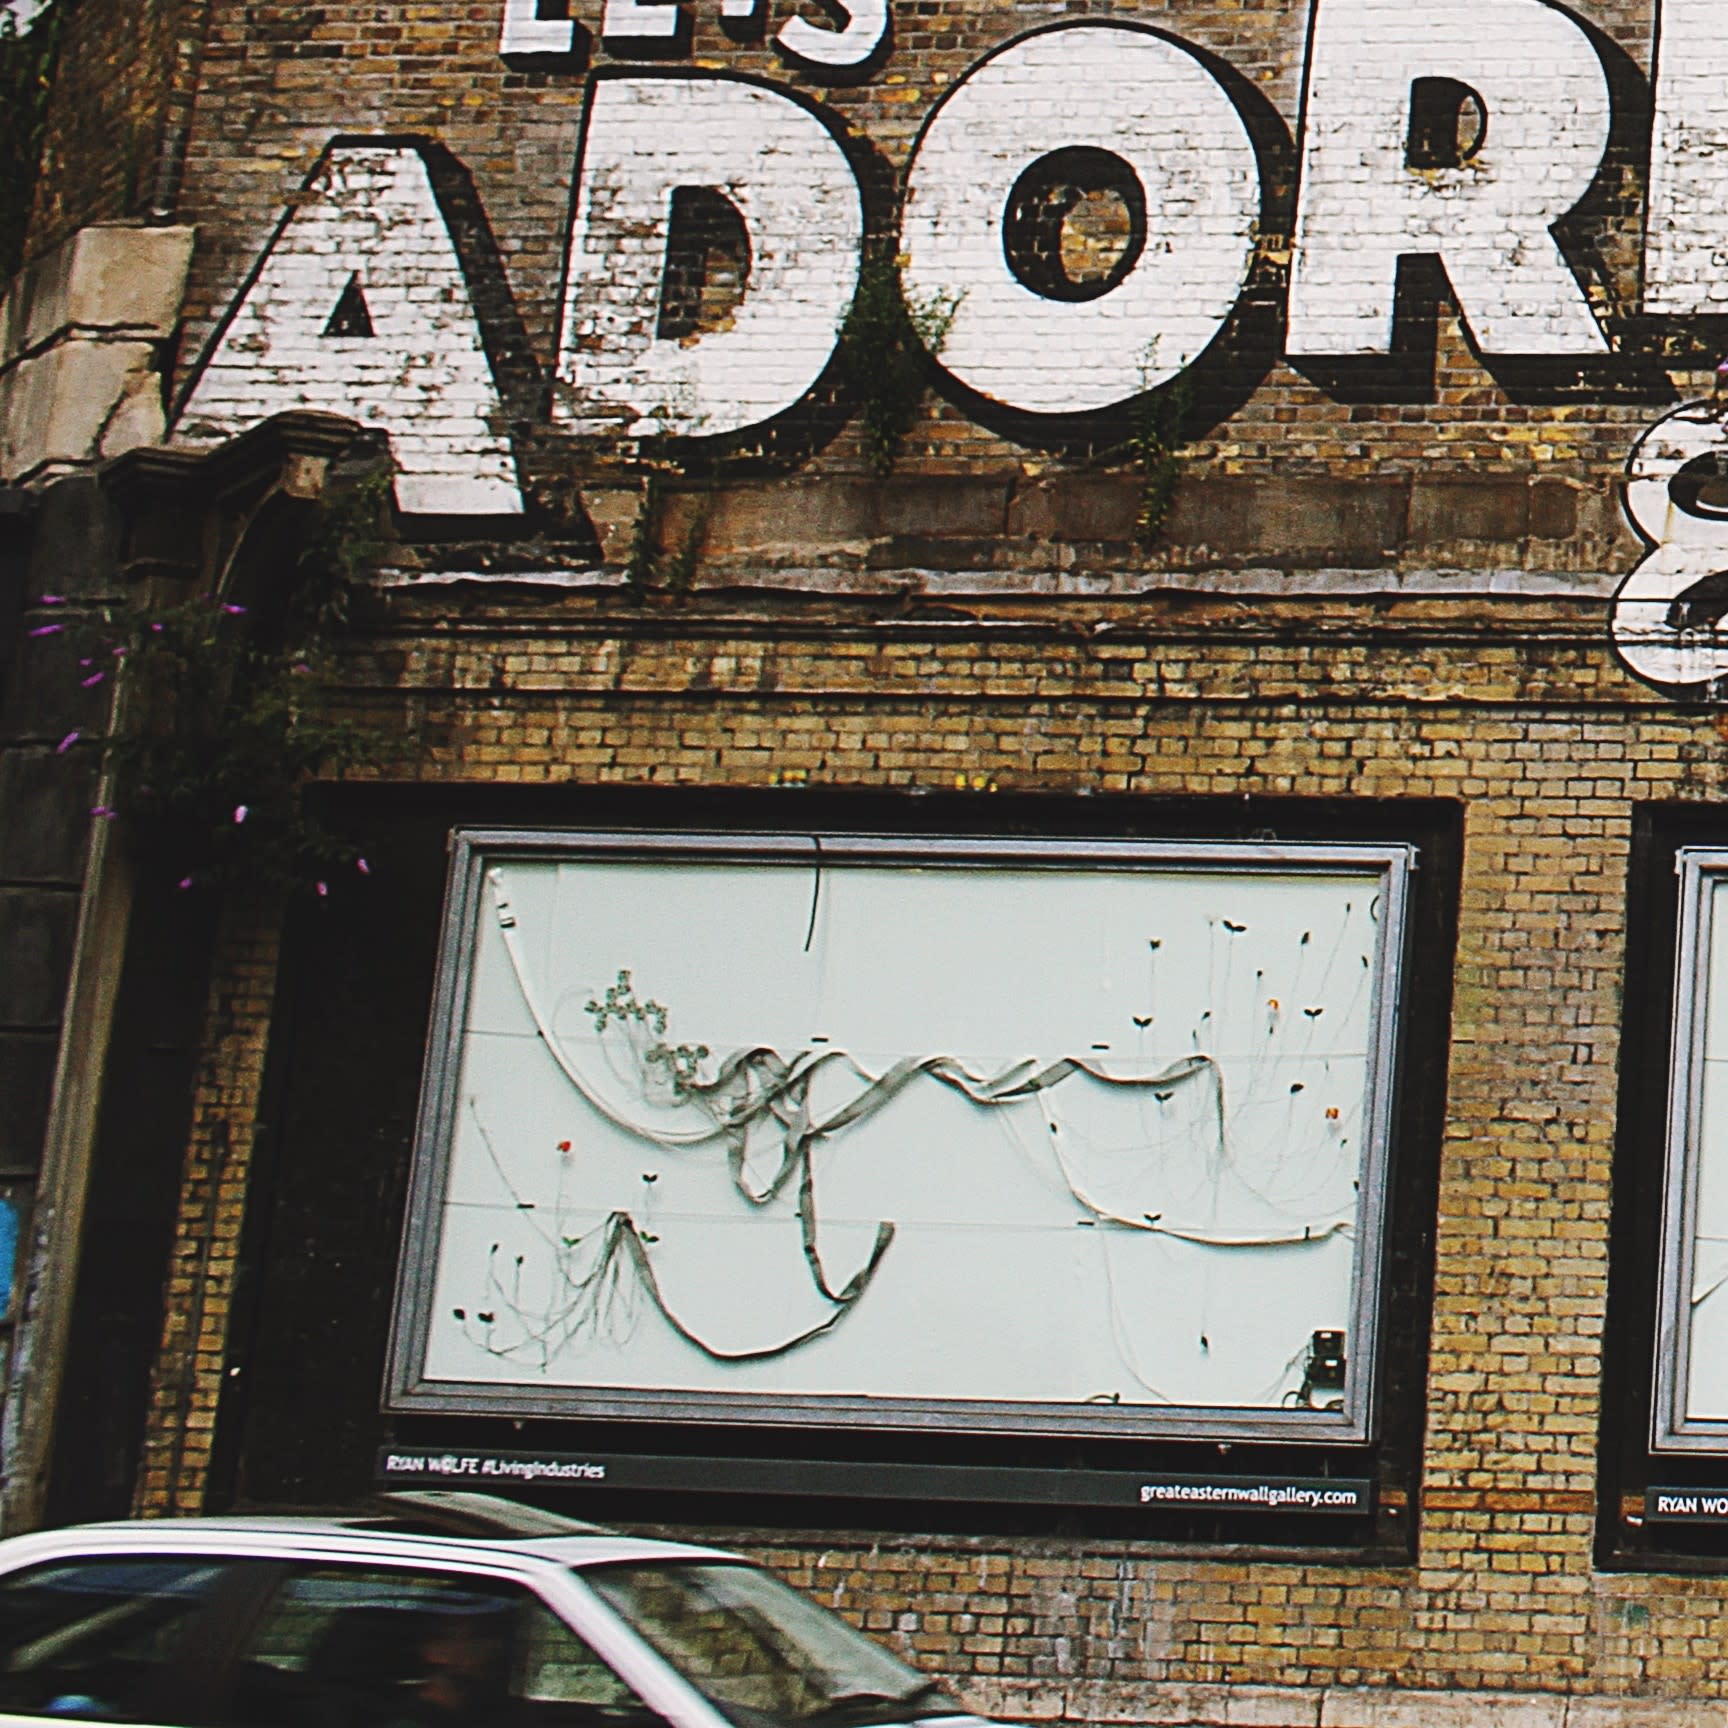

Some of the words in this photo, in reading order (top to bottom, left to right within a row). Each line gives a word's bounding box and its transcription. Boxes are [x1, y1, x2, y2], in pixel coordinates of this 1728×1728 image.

[386, 1454, 425, 1471] RYAN
[427, 1455, 479, 1474] WOLFE
[1140, 1485, 1357, 1508] greateasternwallgallery.com
[1657, 1496, 1697, 1513] RYAN
